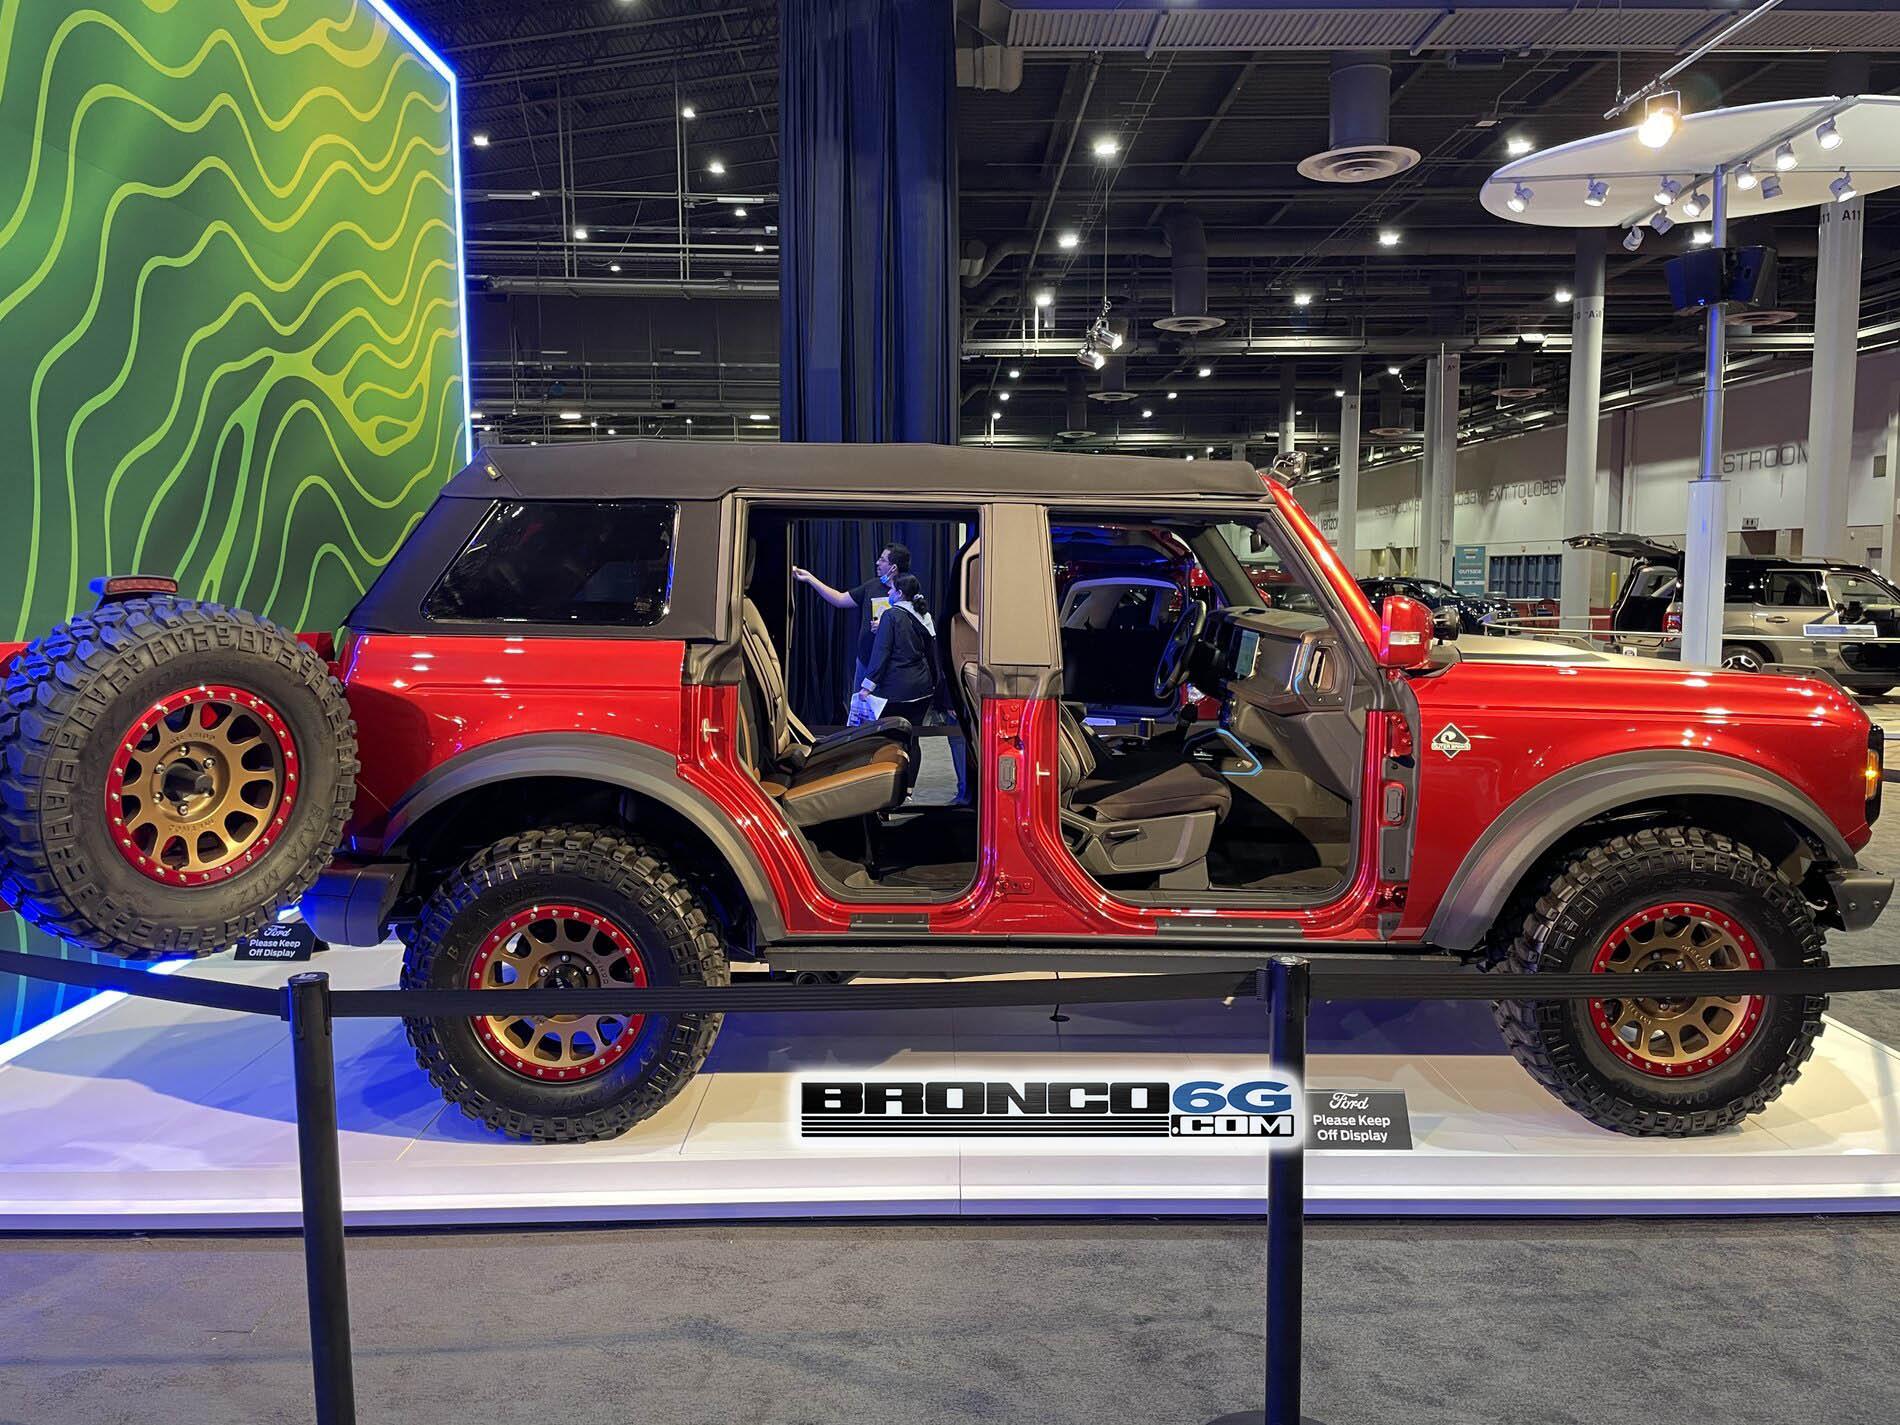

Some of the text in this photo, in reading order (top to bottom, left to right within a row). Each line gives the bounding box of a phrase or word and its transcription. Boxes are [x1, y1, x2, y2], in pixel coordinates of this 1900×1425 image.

[1527, 479, 1567, 497] LOBBY
[264, 925, 292, 937] Ford
[249, 939, 301, 949] Please Keep
[248, 948, 296, 958] Off Display
[1328, 1092, 1369, 1110] Ford
[1312, 1114, 1391, 1128] Please Keep
[1317, 1129, 1388, 1143] Off Display
